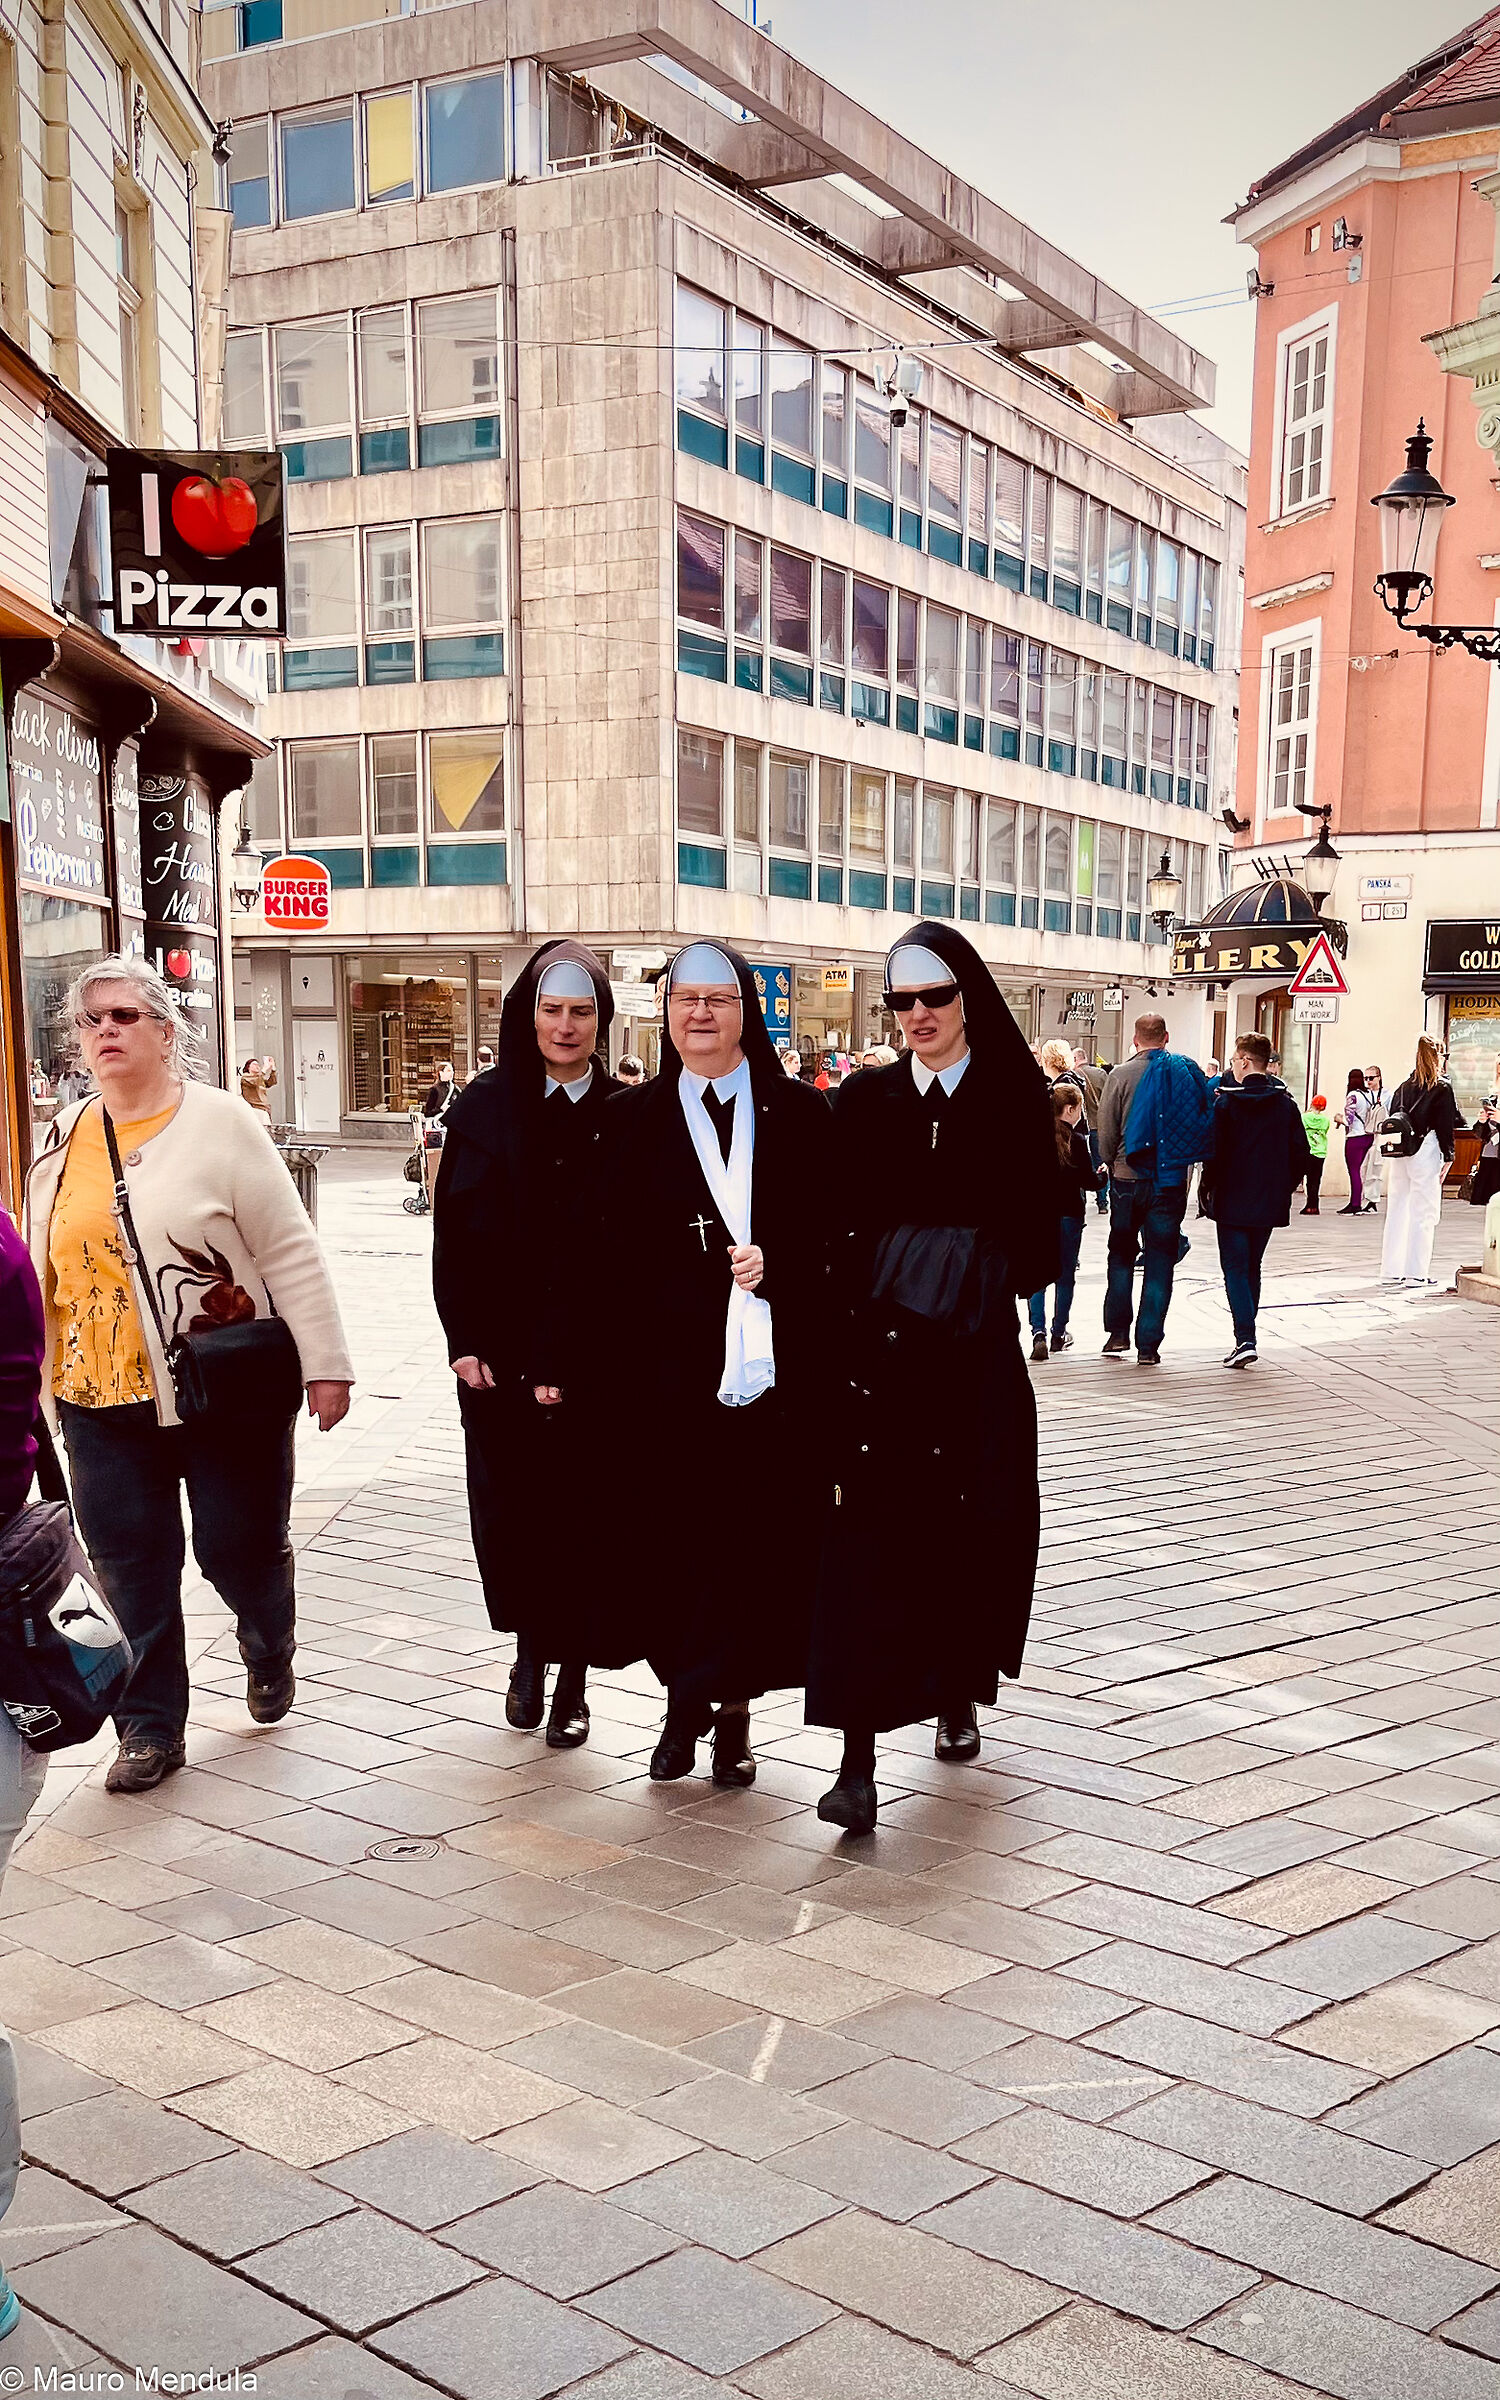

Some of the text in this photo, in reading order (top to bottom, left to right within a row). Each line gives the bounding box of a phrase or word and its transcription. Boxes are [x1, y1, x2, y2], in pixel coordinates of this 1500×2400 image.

[141, 473, 161, 556] I
[119, 569, 278, 629] Pizza
[56, 711, 100, 776] olives
[18, 788, 93, 888] Pepperoni
[263, 880, 328, 896] BURGER
[264, 895, 329, 917] KING
[1173, 937, 1317, 974] LLERY
[1459, 950, 1500, 970] GOLD
[825, 970, 848, 980] ATM
[1454, 996, 1500, 1008] HODIN
[1299, 1011, 1331, 1019] AT WORK
